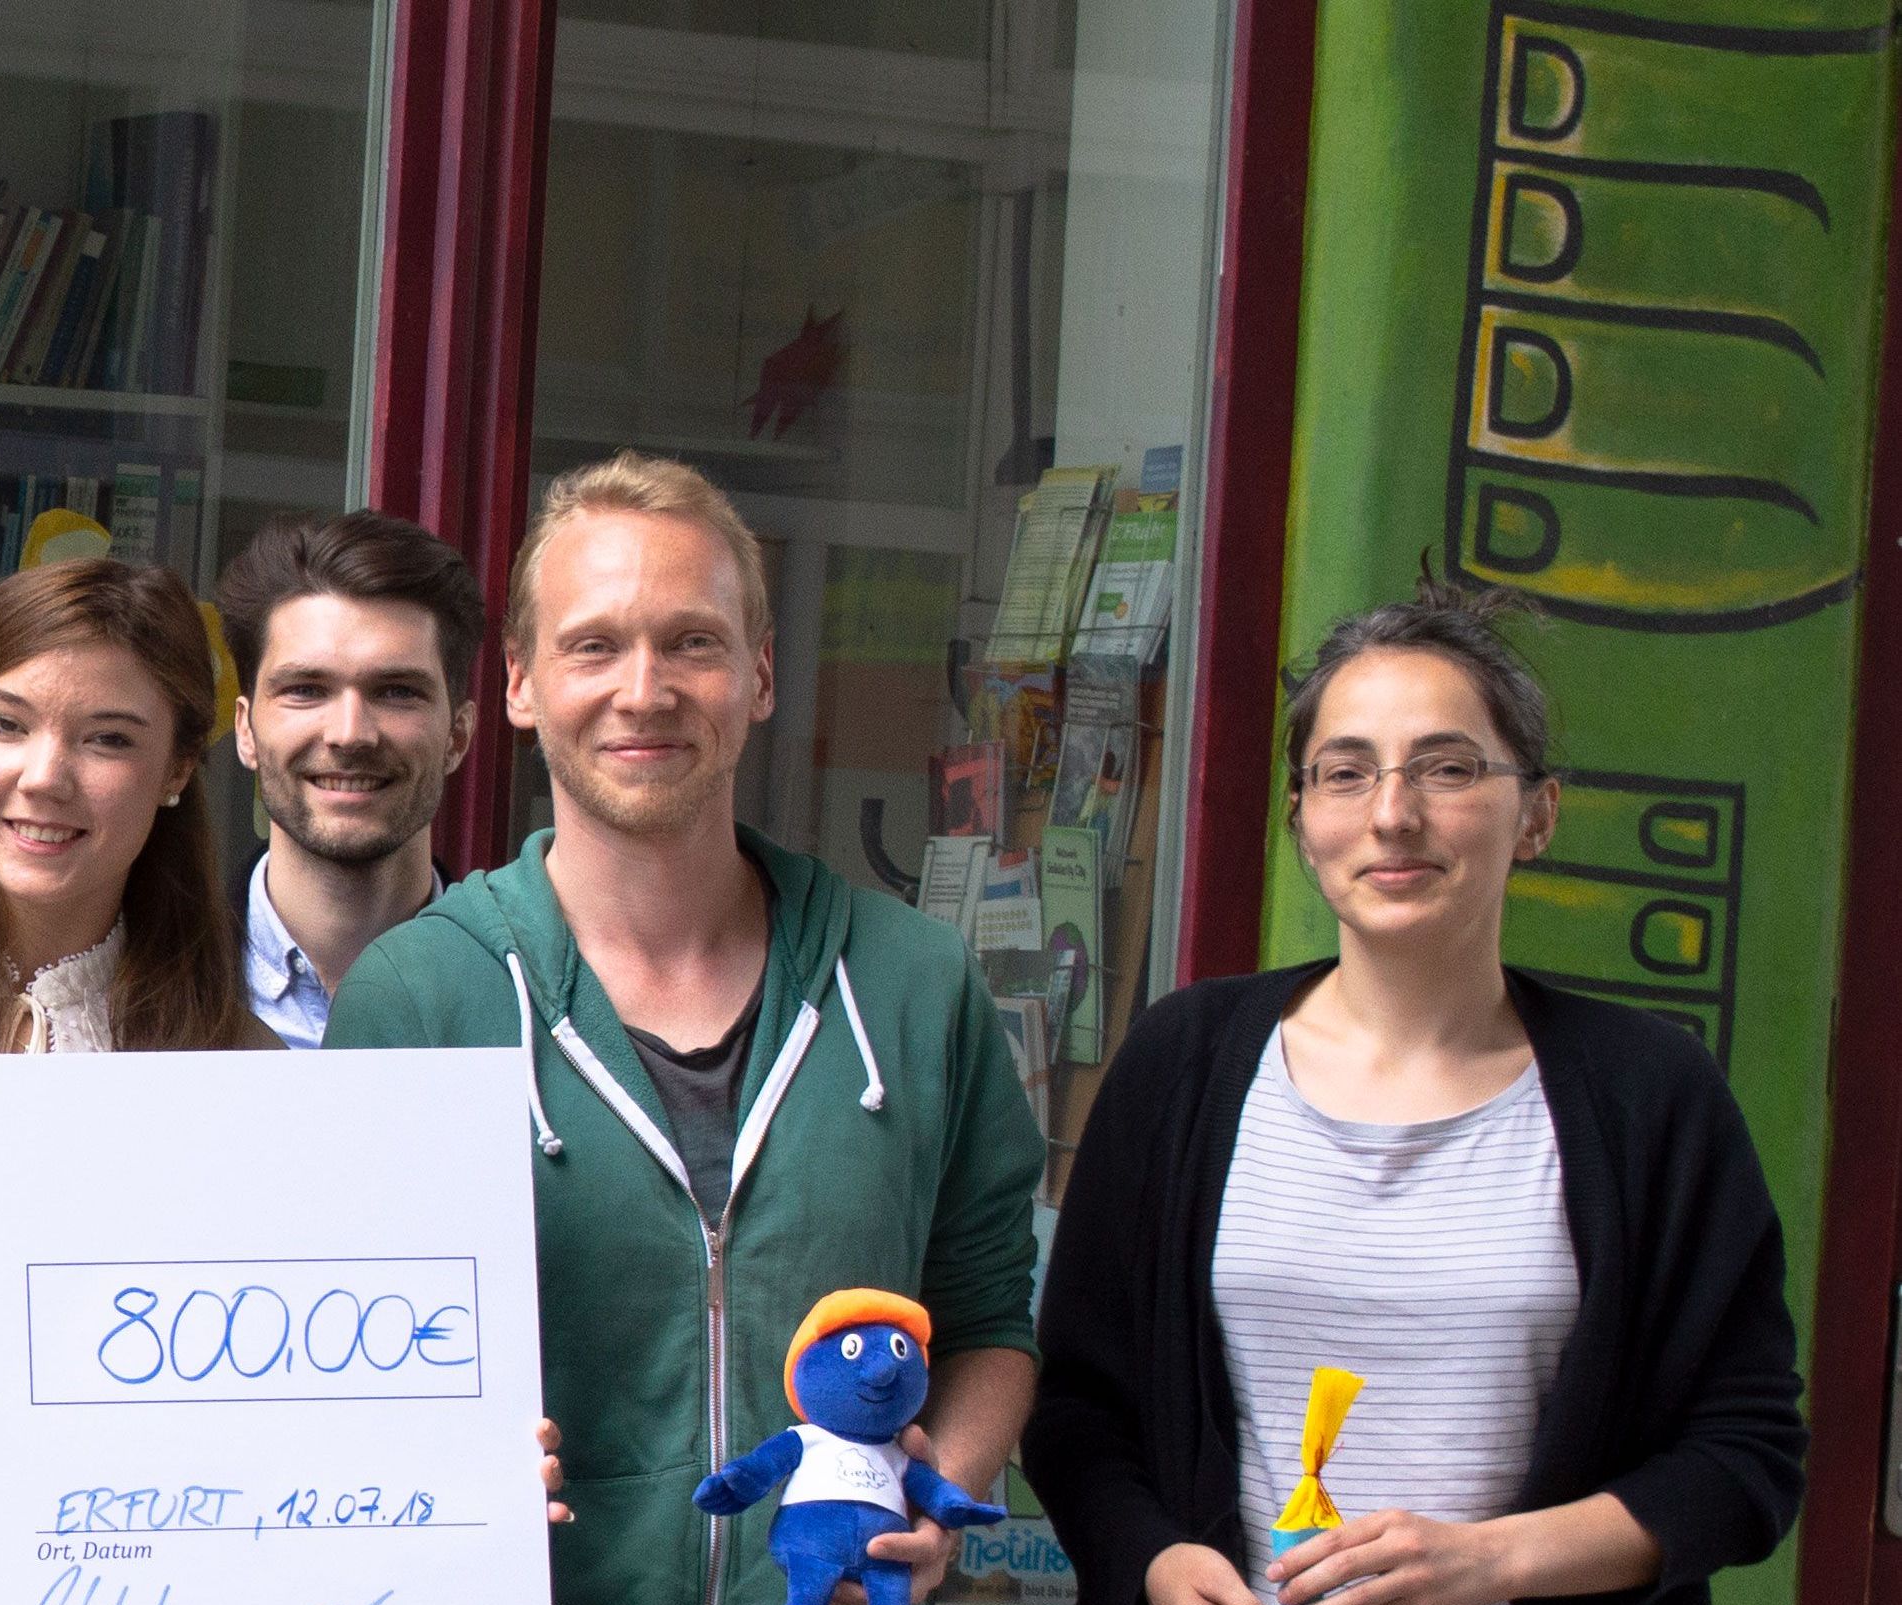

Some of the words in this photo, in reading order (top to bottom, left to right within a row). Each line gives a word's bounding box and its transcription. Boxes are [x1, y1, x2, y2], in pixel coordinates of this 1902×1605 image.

[276, 1486, 436, 1528] 12.07.18
[36, 1541, 77, 1562] Ort,
[82, 1540, 153, 1561] Datum
